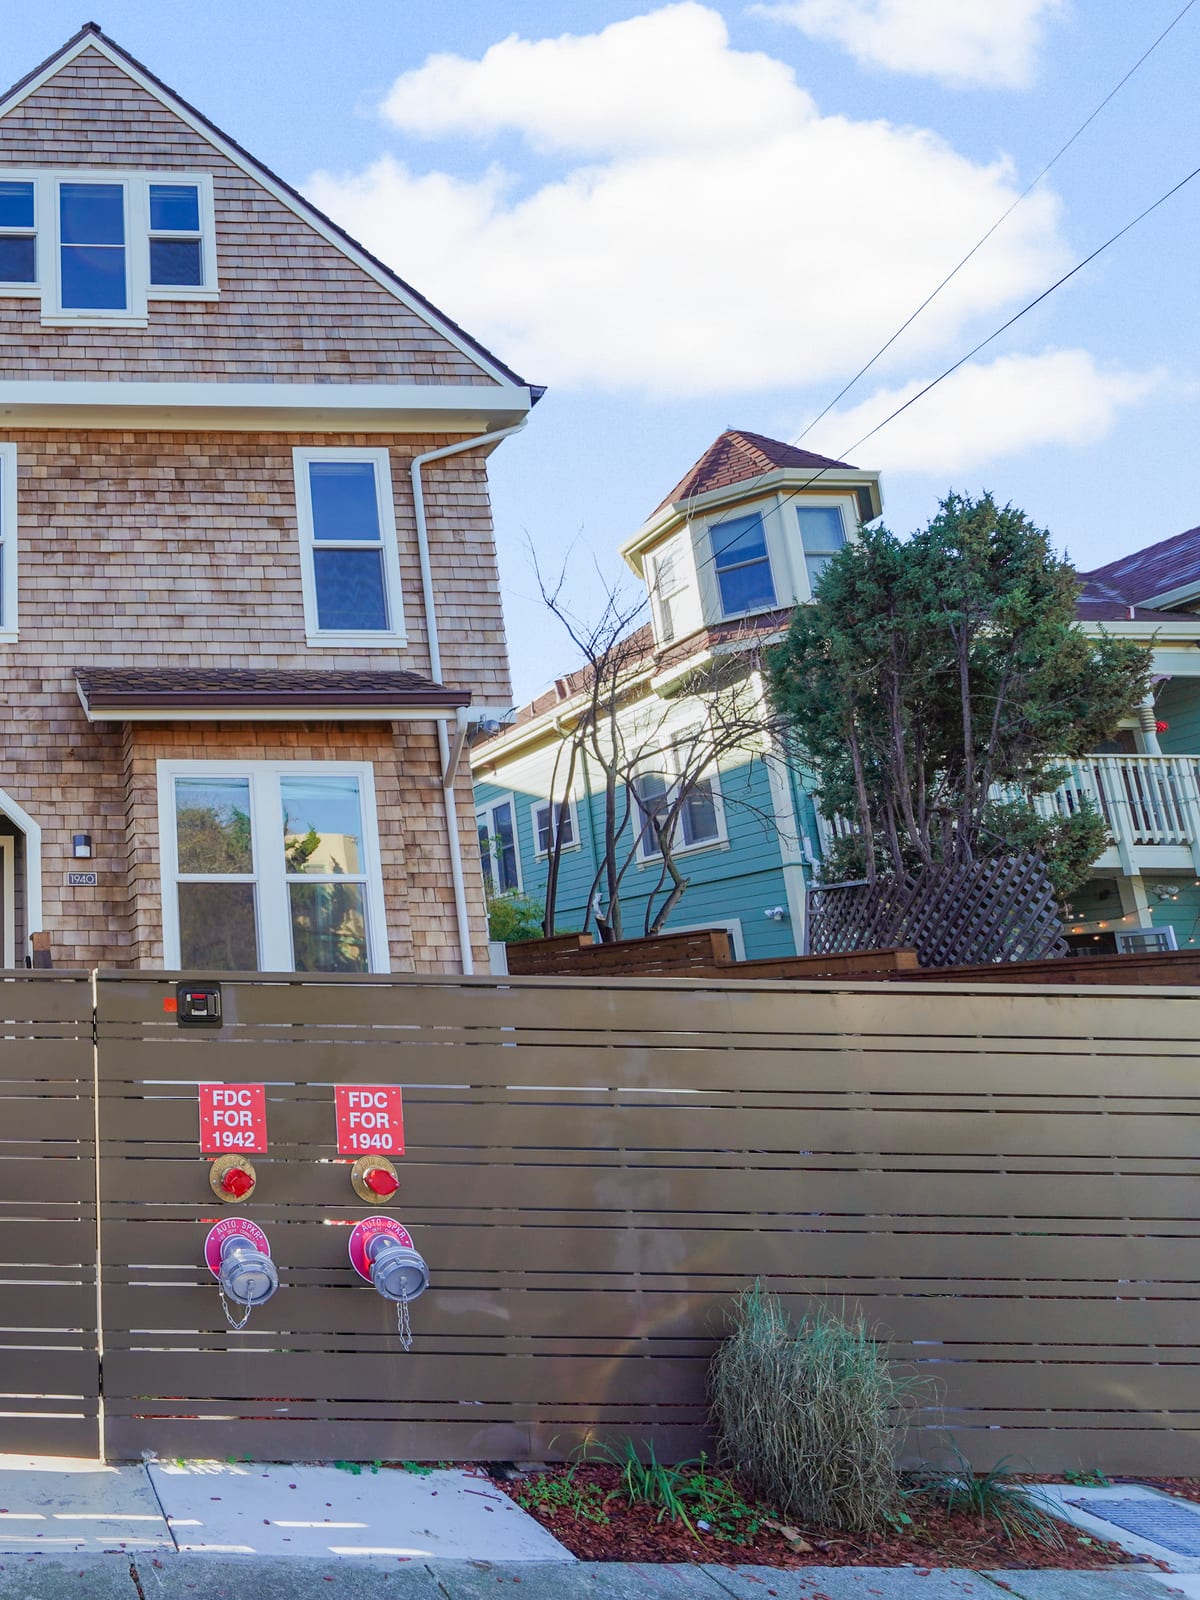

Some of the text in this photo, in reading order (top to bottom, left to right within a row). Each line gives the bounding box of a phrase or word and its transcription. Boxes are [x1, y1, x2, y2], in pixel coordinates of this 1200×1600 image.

[70, 874, 94, 884] 1940
[212, 1090, 251, 1107] FDC
[348, 1092, 388, 1108] FDC
[213, 1111, 252, 1127] FOR
[350, 1113, 389, 1129] FOR
[212, 1132, 255, 1147] 1942
[350, 1134, 392, 1149] 1940
